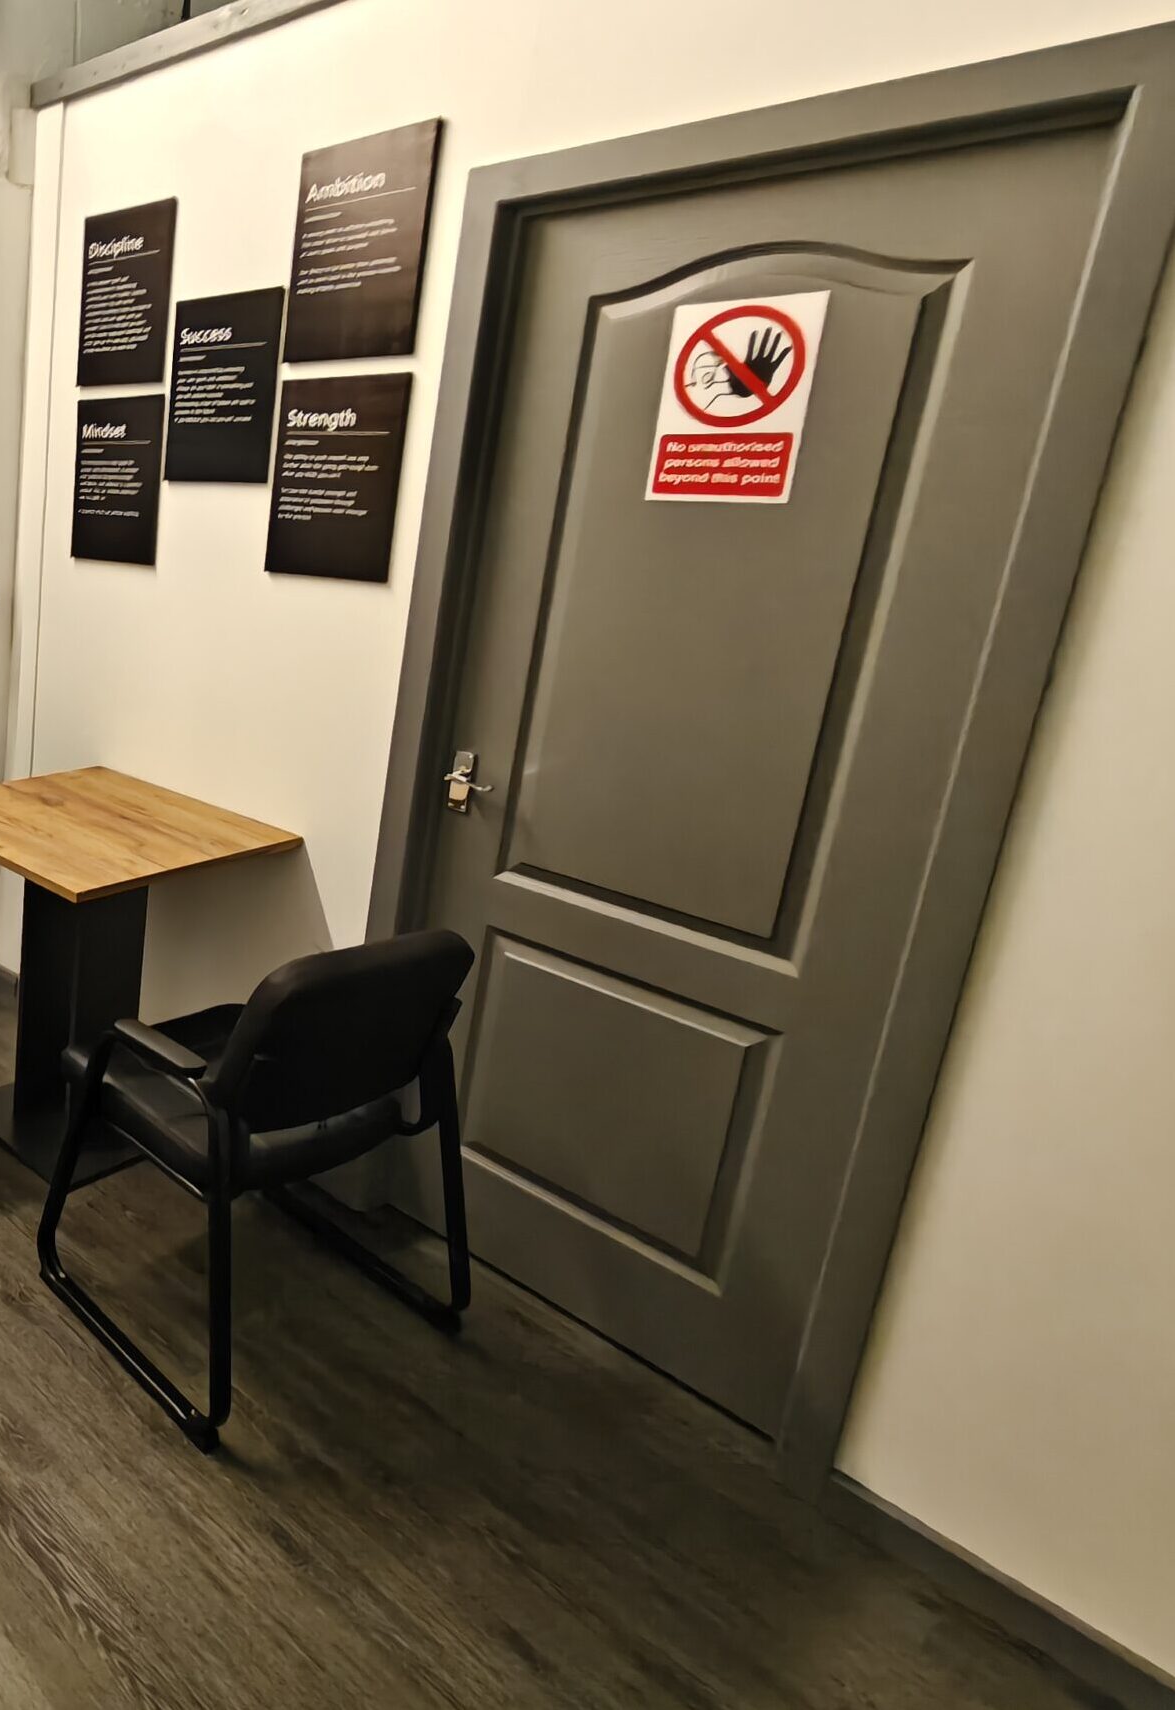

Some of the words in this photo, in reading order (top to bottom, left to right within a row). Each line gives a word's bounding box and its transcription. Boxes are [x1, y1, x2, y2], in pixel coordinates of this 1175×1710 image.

[305, 172, 386, 203] Ambition
[88, 235, 144, 259] Discipline
[179, 326, 233, 346] Success
[286, 407, 357, 431] Strength
[82, 422, 127, 439] Mindset
[666, 441, 686, 453] No
[688, 441, 784, 453] unauthorised
[664, 457, 720, 468] persons
[722, 457, 780, 468] allowed
[658, 472, 709, 485] beyond
[711, 473, 738, 484] this
[740, 472, 781, 486] point
